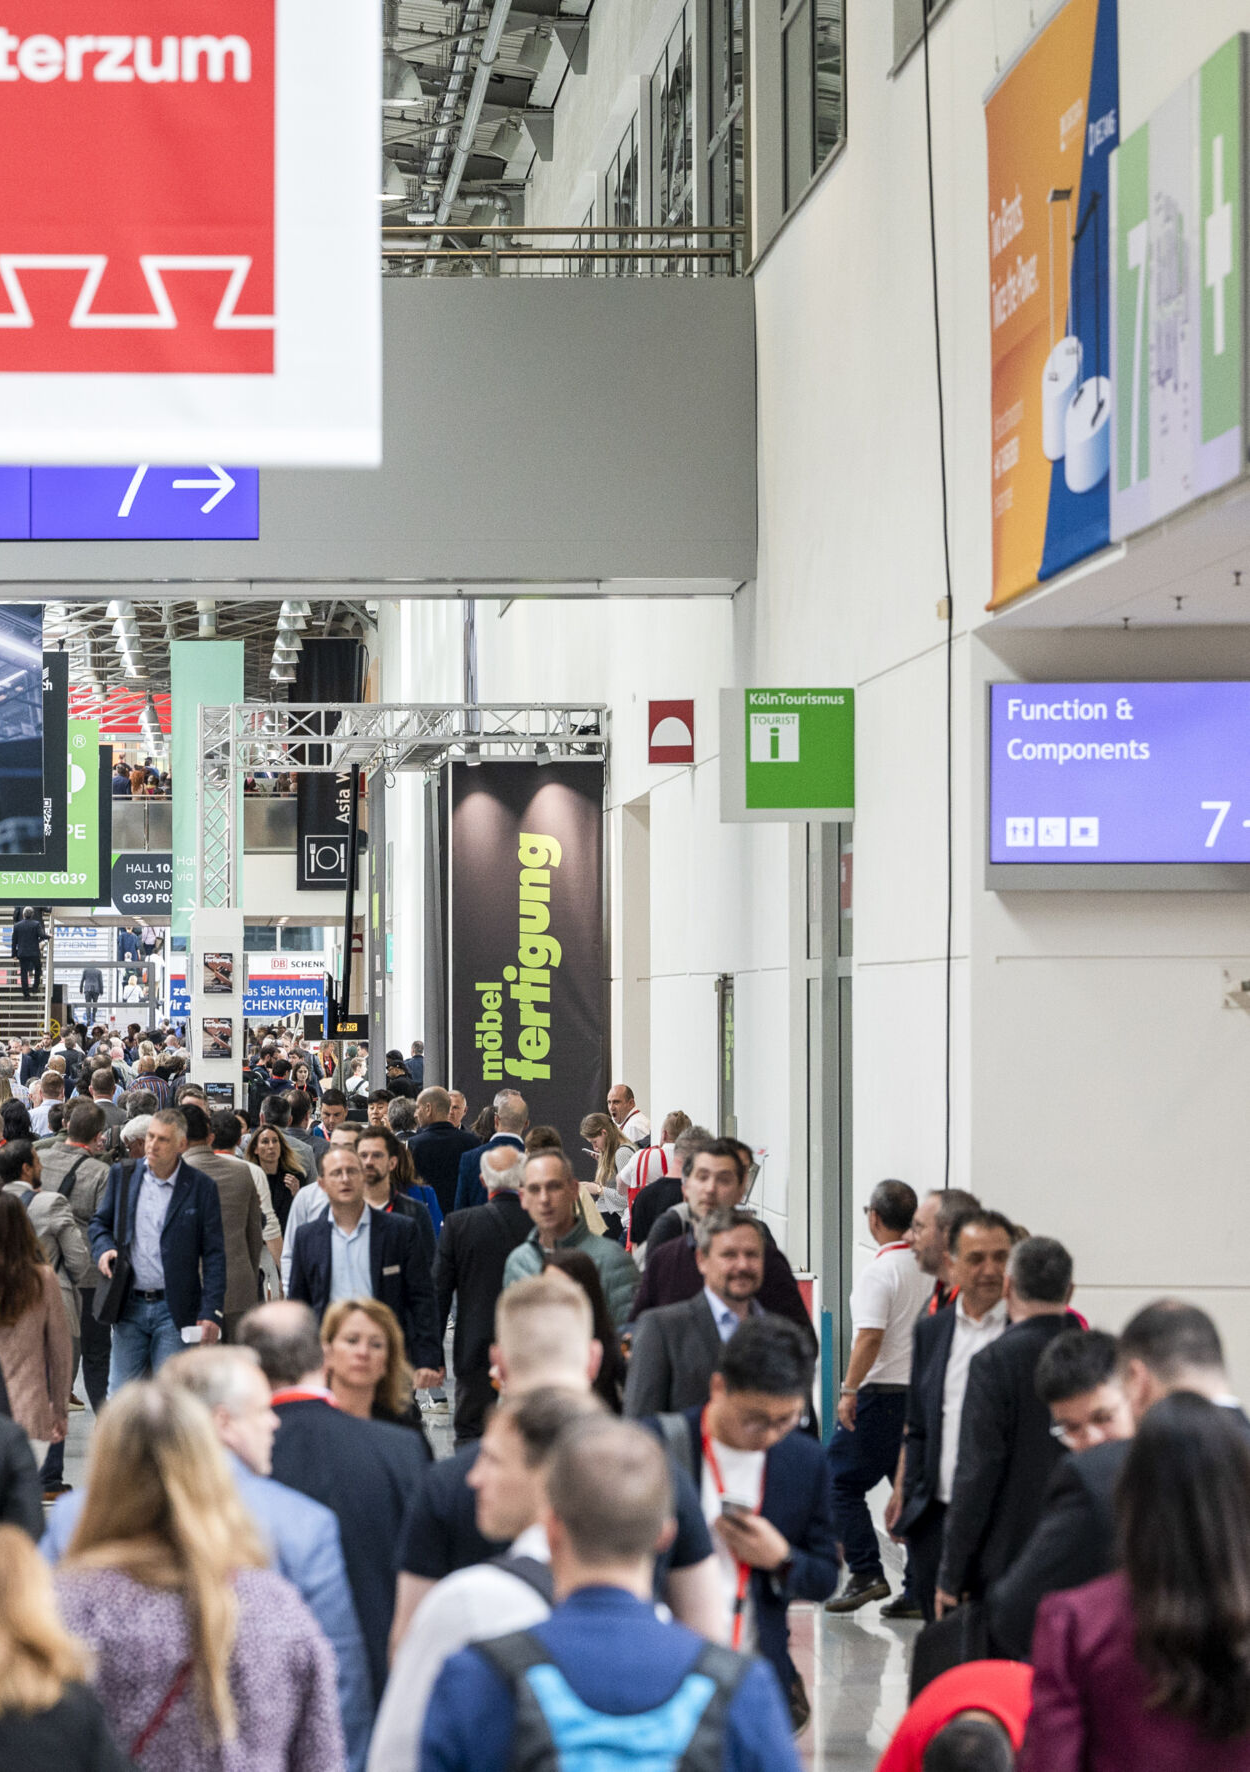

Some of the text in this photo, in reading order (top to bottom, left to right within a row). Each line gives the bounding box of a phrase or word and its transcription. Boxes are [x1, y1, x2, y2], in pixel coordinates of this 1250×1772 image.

[749, 692, 845, 705] KölnTourismus
[1007, 698, 1134, 721] Function &
[753, 716, 797, 725] TOURIST
[1007, 738, 1150, 765] Components
[335, 789, 350, 824] Asia
[1201, 801, 1232, 848] 7
[126, 864, 154, 873] HALL
[1, 873, 46, 885] STAND
[49, 873, 87, 885] G039
[135, 880, 171, 890] STAND
[122, 893, 153, 904] G039
[502, 832, 562, 1081] fertigung
[261, 985, 276, 996] Sie
[279, 985, 320, 996] können.
[243, 1000, 325, 1012] CHENKERfair
[475, 982, 503, 1081] möbel
